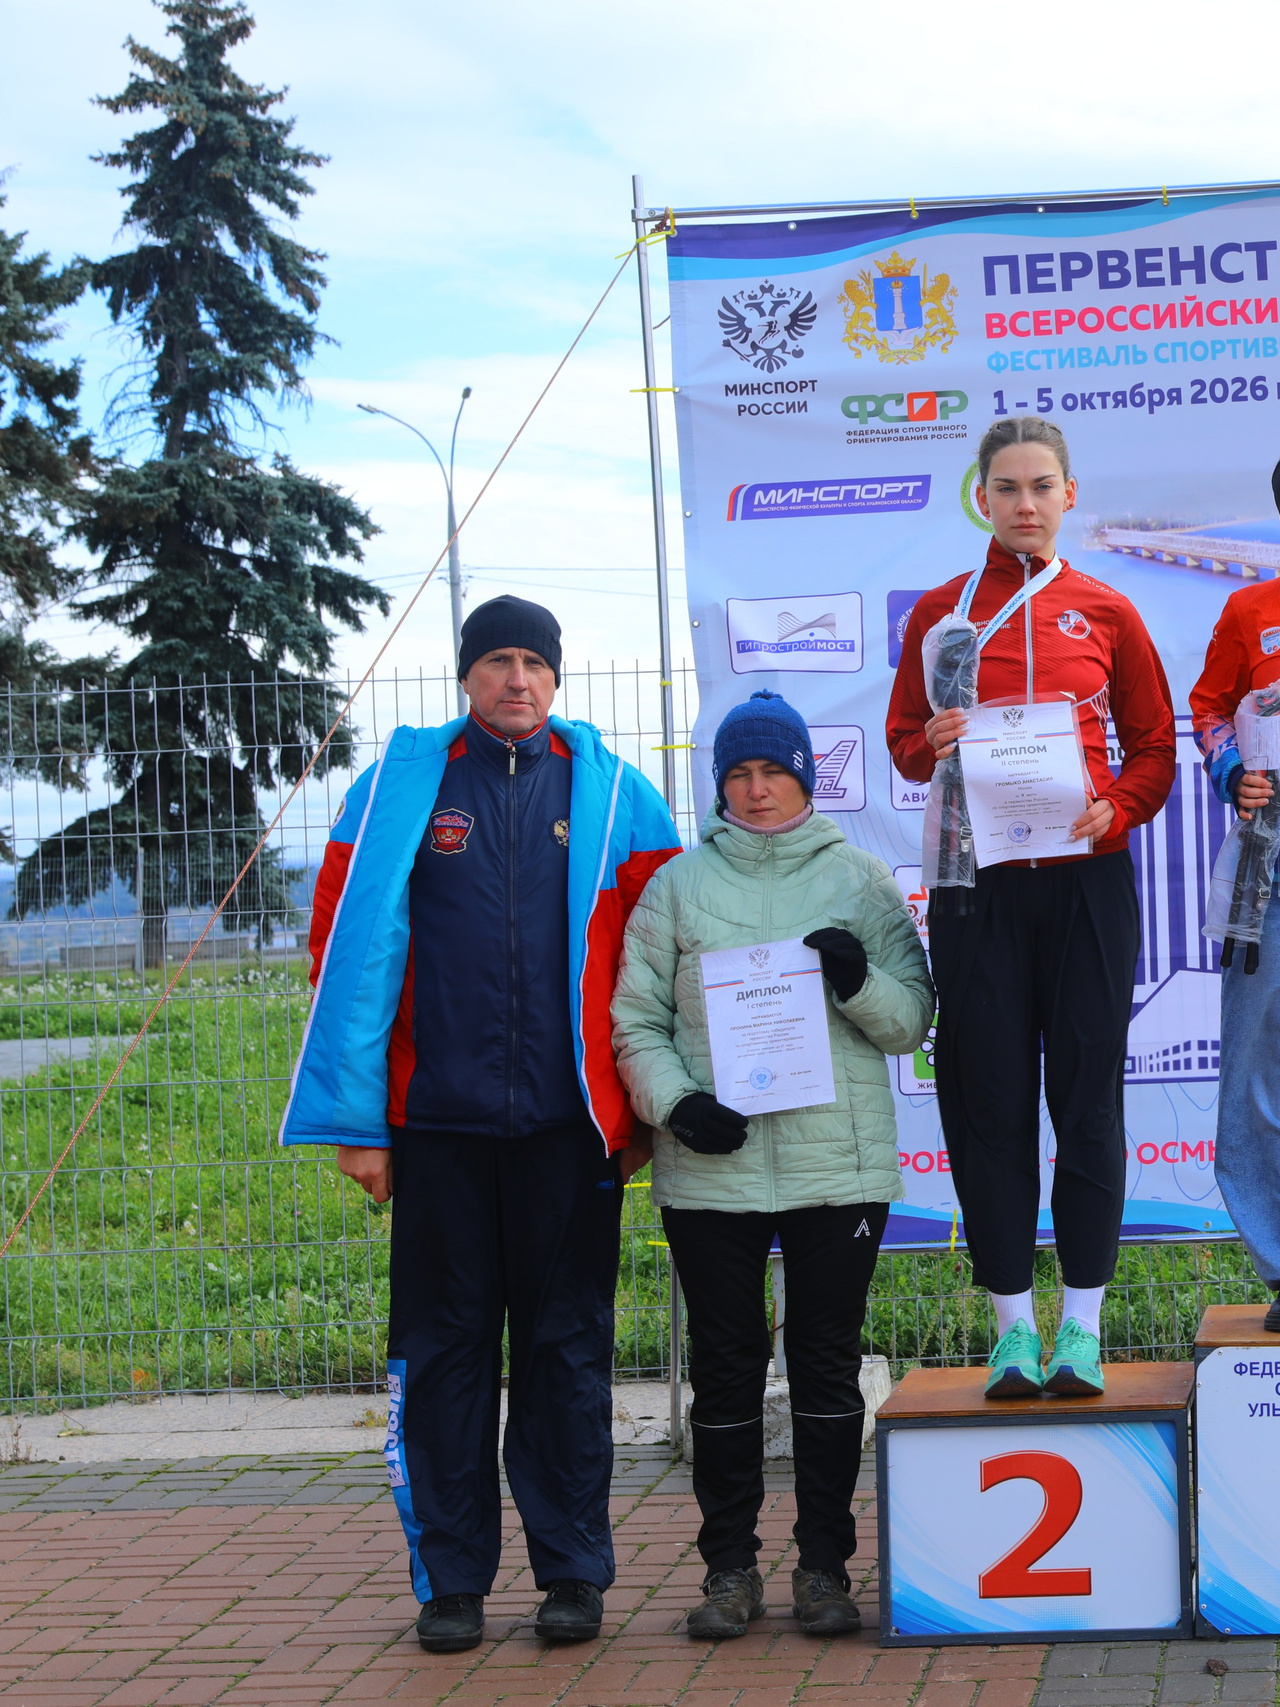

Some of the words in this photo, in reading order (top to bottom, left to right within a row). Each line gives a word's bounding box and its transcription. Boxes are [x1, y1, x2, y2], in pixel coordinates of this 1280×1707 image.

[986, 344, 1148, 374] ФЕСТИВАЛЬ
[724, 379, 818, 397] МИНСПОРТ
[1061, 383, 1182, 415] октября
[1190, 375, 1269, 404] 2026
[737, 400, 809, 417] РОССИИ
[846, 427, 900, 437] ФЕДЕРАЦИЯ
[902, 424, 968, 434] СПОРТИВНОГО
[846, 435, 929, 445] ОРИЕНТИРОВАНИЯ
[930, 432, 968, 441] РОССИИ
[754, 481, 923, 506] МИНСПОРТ
[991, 745, 1047, 758] ДИПЛОМ
[736, 984, 792, 1002] ДИПЛОМ
[751, 1000, 783, 1010] степень
[978, 1449, 1092, 1600] 2
